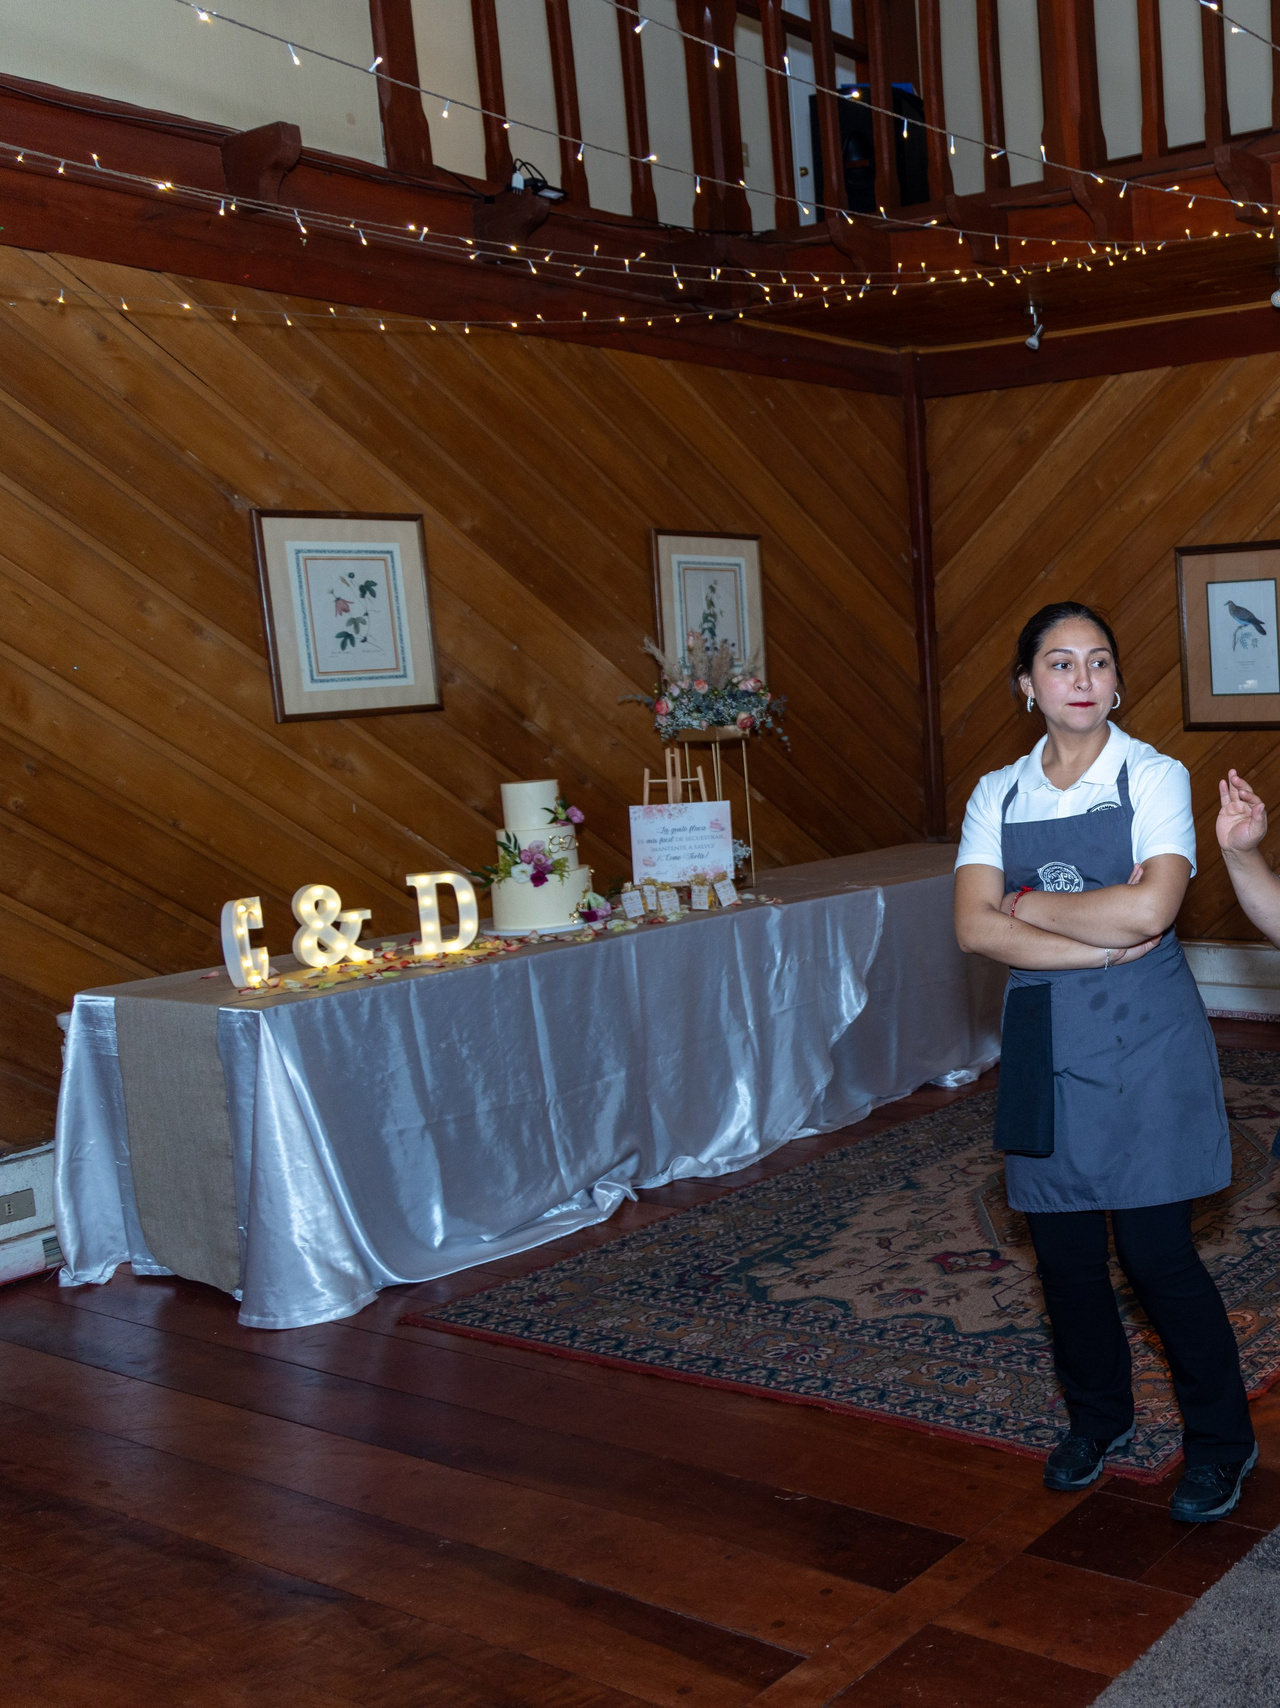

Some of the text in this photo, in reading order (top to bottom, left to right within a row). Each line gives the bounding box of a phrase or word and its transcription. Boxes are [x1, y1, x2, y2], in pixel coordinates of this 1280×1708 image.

[671, 826, 687, 834] gente
[291, 884, 374, 968] &
[406, 871, 479, 956] D
